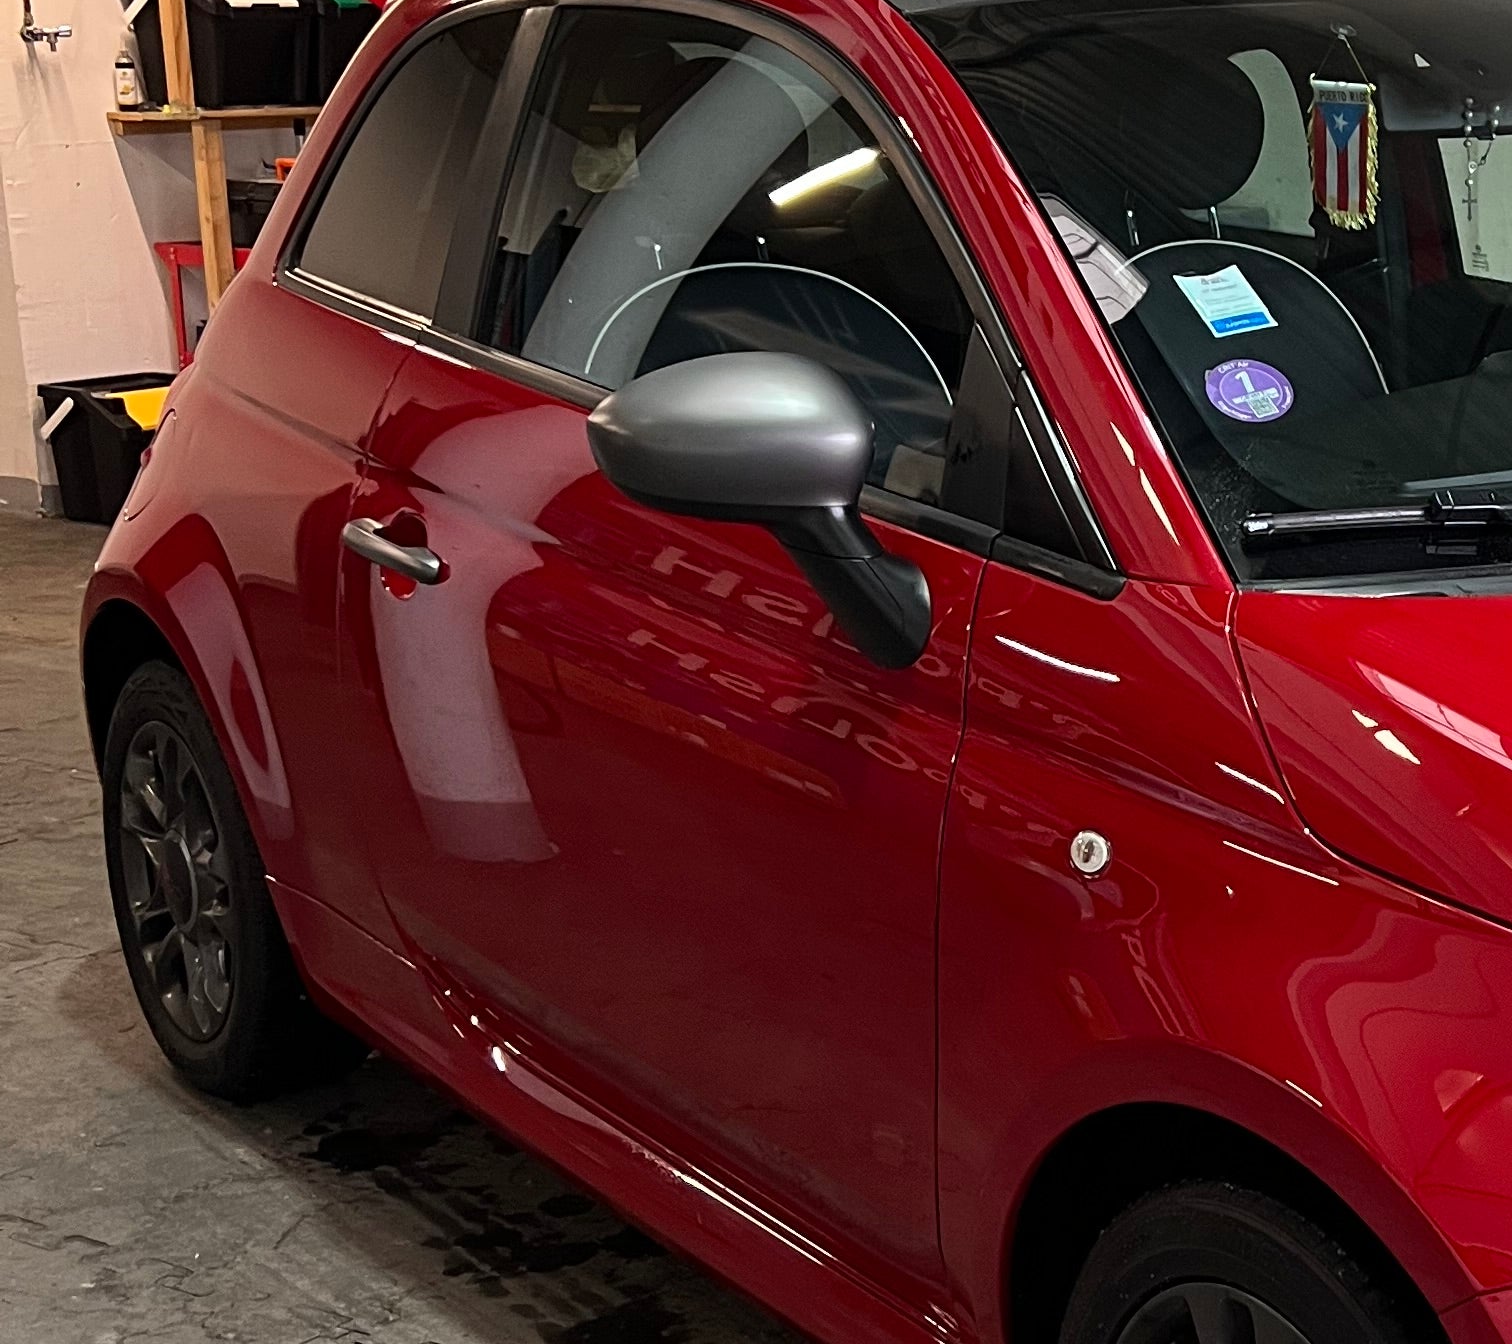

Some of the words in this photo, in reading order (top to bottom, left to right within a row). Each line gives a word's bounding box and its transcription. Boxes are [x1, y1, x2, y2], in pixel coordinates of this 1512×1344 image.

[1320, 90, 1347, 102] PUERTO
[1349, 91, 1367, 103] RIC
[1234, 370, 1255, 393] 1
